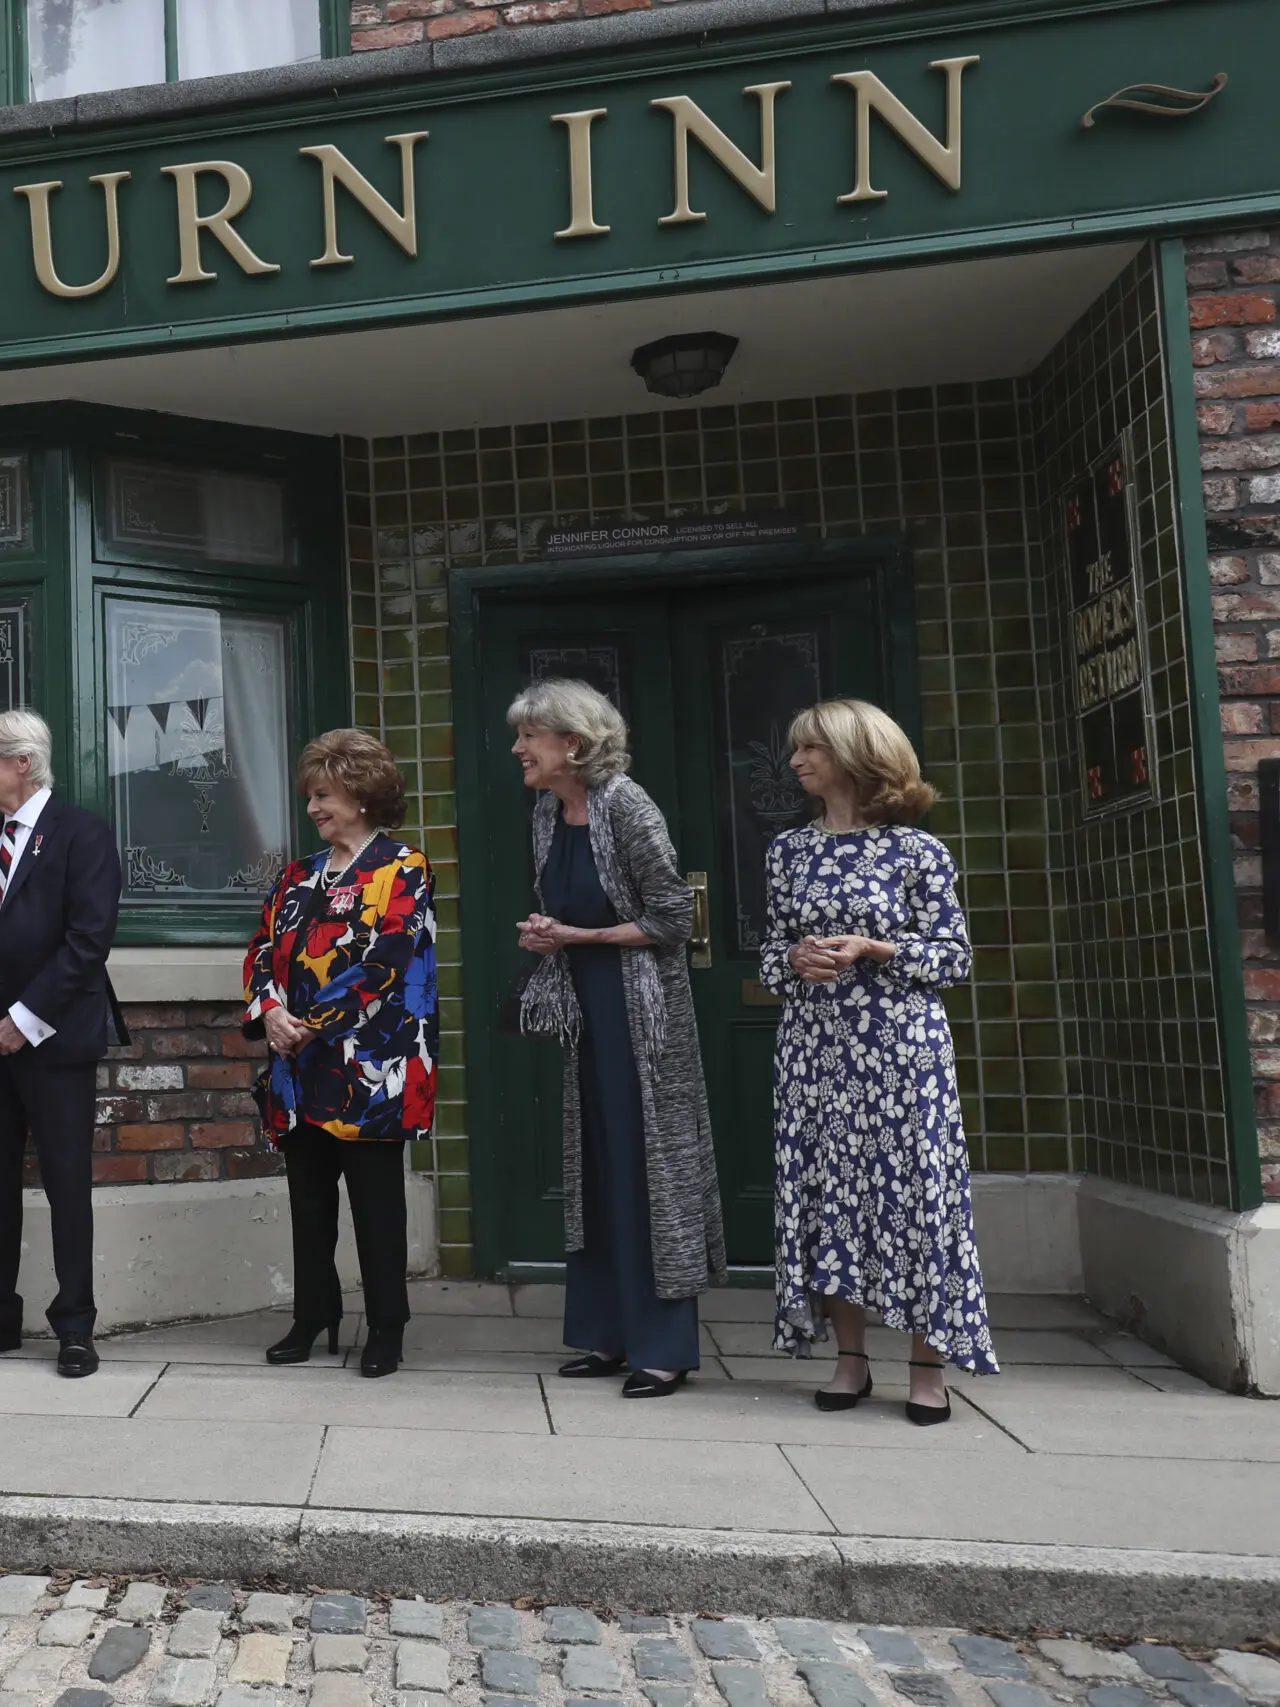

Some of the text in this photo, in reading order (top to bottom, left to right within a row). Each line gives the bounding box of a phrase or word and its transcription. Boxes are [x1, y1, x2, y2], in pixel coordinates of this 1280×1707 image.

[549, 54, 980, 241] INN
[547, 520, 759, 545] JENNIFER CONNOR LICENSED TO SELL ALL
[547, 543, 597, 553] INTOXICATING
[598, 541, 626, 550] LIQUOR
[627, 539, 643, 547] FOR
[644, 534, 698, 546] CONSUMPTION
[725, 531, 739, 539] OFF
[741, 529, 756, 537] THE
[758, 526, 797, 536] PREMISES
[1085, 549, 1114, 594] THE
[1075, 581, 1134, 655] ROVERS
[1079, 636, 1139, 709] RETURN
